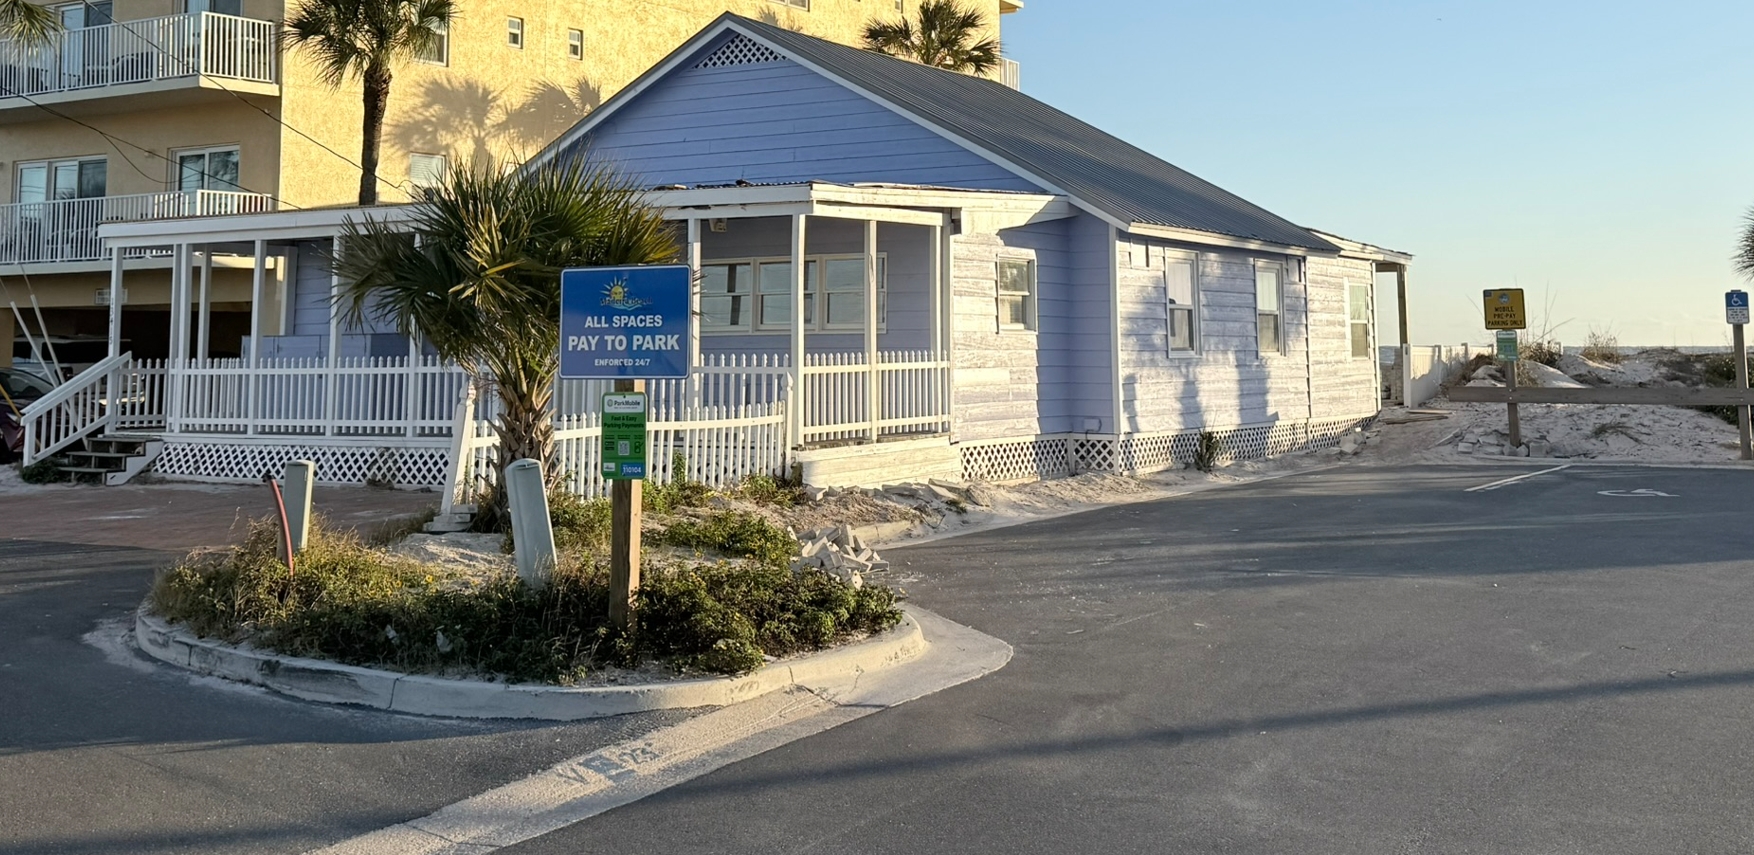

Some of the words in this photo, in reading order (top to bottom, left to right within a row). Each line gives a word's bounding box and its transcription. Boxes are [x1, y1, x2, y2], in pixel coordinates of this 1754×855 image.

[585, 316, 609, 328] ALL
[612, 314, 663, 327] SPACES
[568, 335, 600, 351] PAY
[604, 335, 627, 350] TO
[632, 334, 680, 350] PARK
